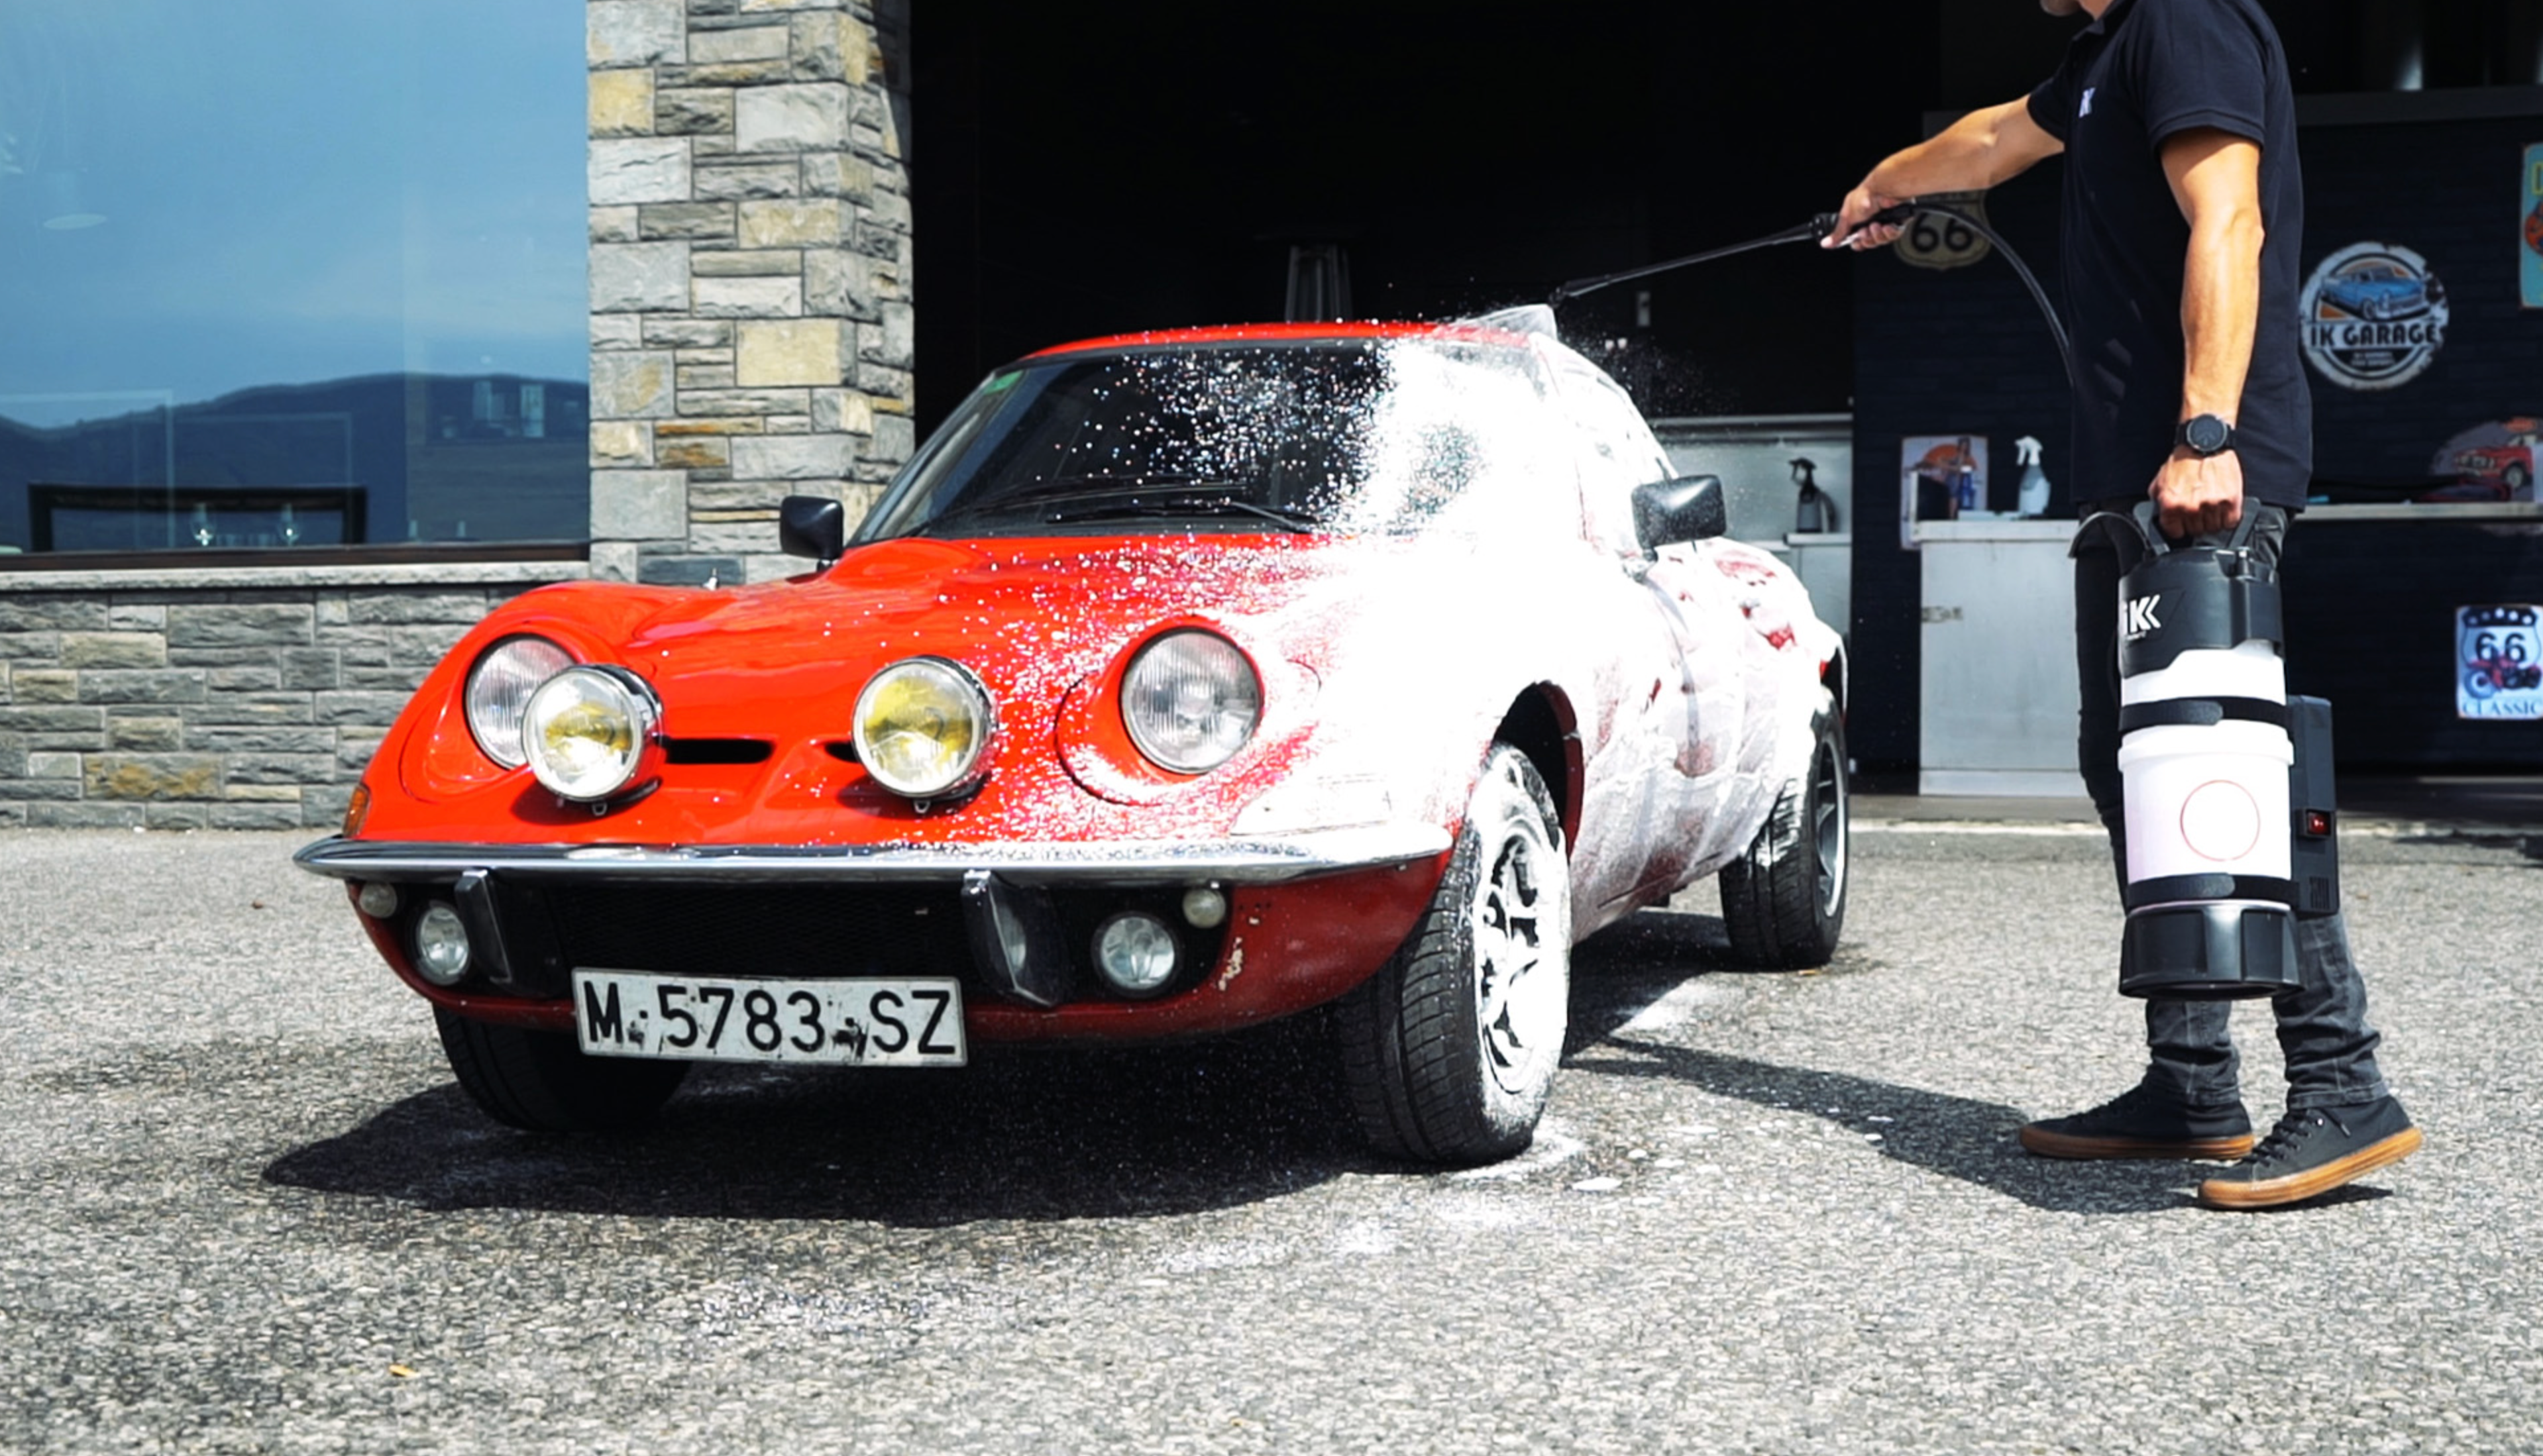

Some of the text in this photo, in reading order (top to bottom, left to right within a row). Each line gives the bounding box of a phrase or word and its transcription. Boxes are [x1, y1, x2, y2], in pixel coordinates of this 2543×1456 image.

[1911, 211, 1974, 254] 66
[2311, 323, 2436, 346] IK GARAGE
[2475, 632, 2527, 664] 66
[2463, 700, 2542, 716] CLASSIC
